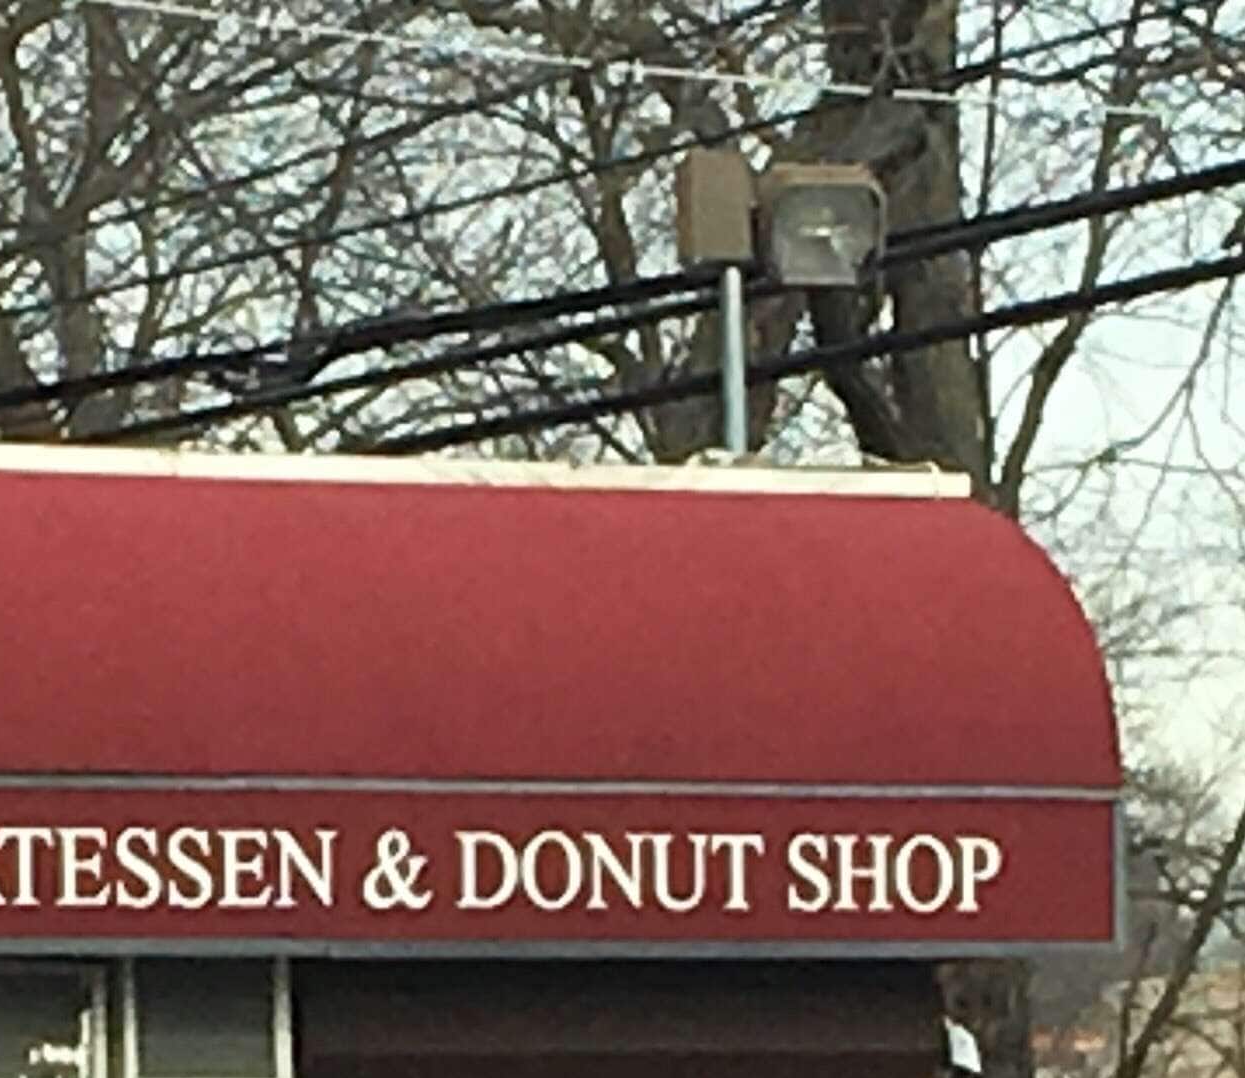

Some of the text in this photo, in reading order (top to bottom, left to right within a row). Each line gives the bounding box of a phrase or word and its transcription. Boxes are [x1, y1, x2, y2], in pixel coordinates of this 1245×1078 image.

[363, 829, 433, 909] &
[455, 832, 765, 912] DONUT
[787, 834, 1002, 913] SHOP
